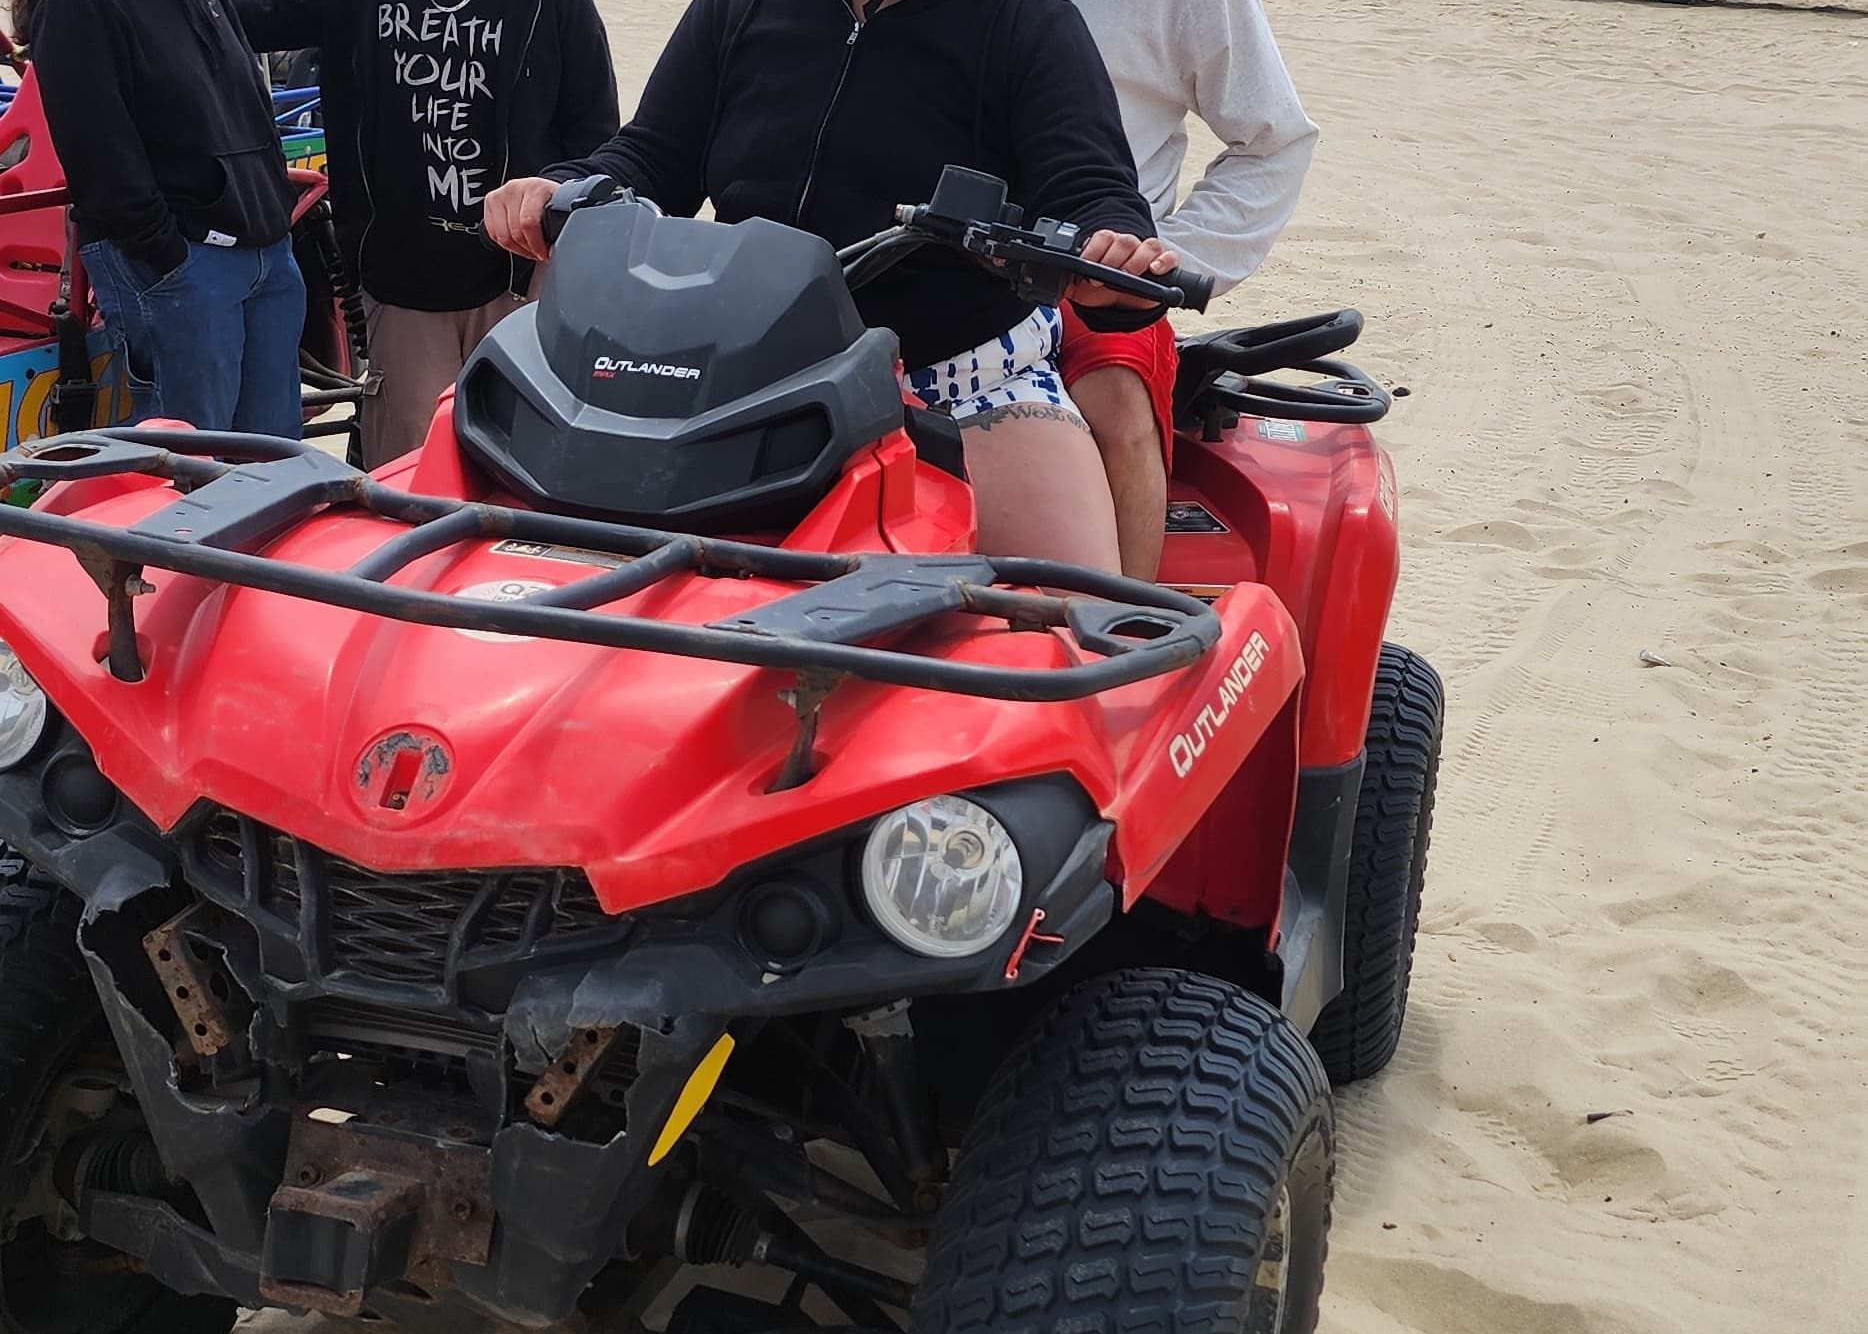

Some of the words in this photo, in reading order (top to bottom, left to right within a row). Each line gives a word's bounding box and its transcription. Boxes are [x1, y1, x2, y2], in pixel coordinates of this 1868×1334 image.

[378, 2, 503, 57] BREATH
[393, 48, 495, 100] YOUR
[411, 92, 473, 131] LIFE
[422, 131, 482, 162] INTO
[427, 164, 488, 214] ME
[594, 356, 701, 380] OUTLANDER
[1168, 630, 1270, 779] OUTLANDER
